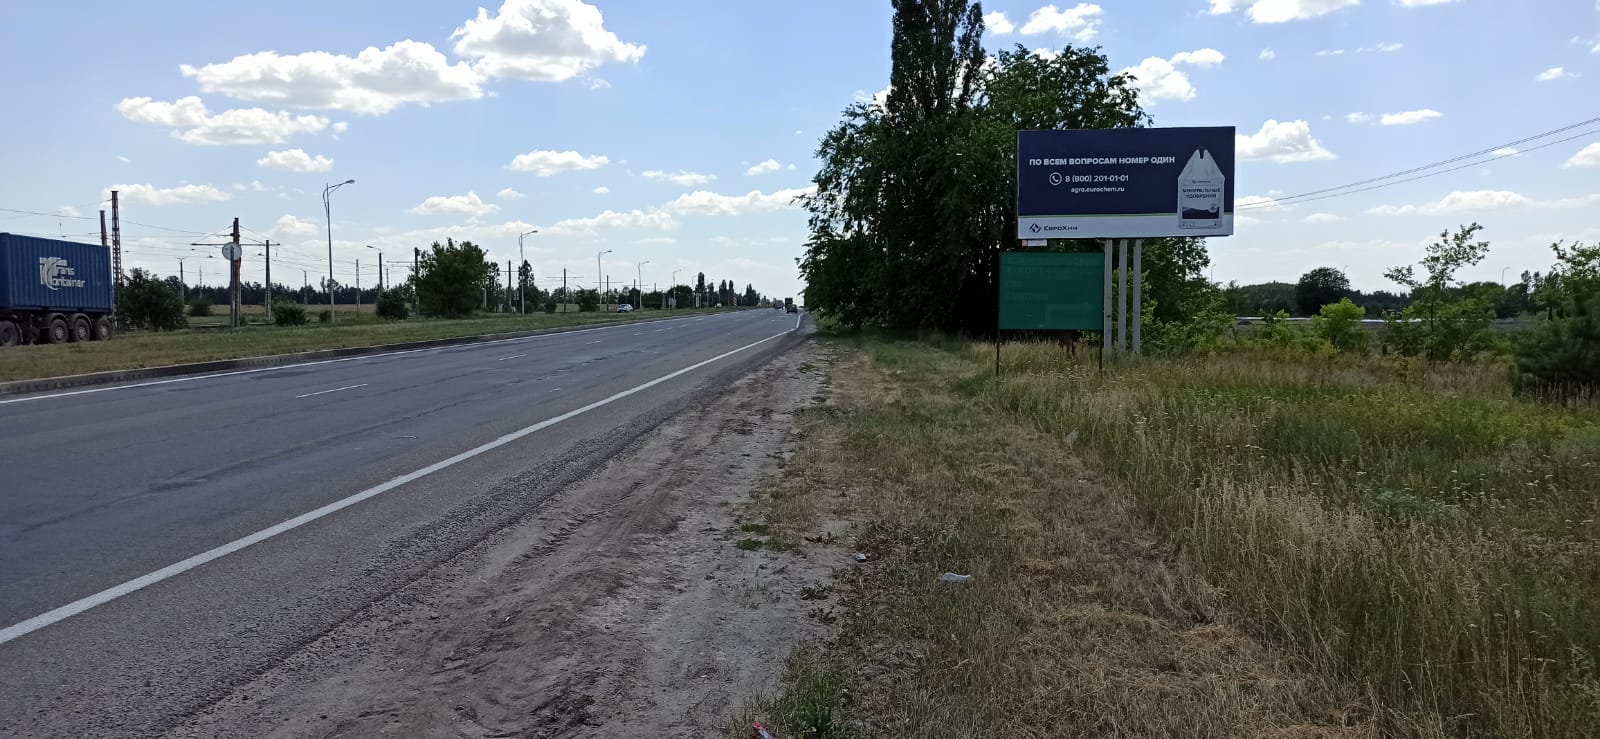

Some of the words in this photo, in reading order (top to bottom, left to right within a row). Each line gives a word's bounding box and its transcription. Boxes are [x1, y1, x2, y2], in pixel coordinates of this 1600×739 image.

[1029, 158, 1042, 166] ПО
[1068, 157, 1117, 165] ВОПРОСАМ
[1119, 157, 1149, 165] НОМЕР
[1150, 156, 1176, 164] ОДИН
[1064, 175, 1071, 183] 8
[1072, 175, 1092, 183] (800)
[1094, 174, 1129, 182] 201-01-01
[1070, 186, 1125, 194] agro.eurochem.ru
